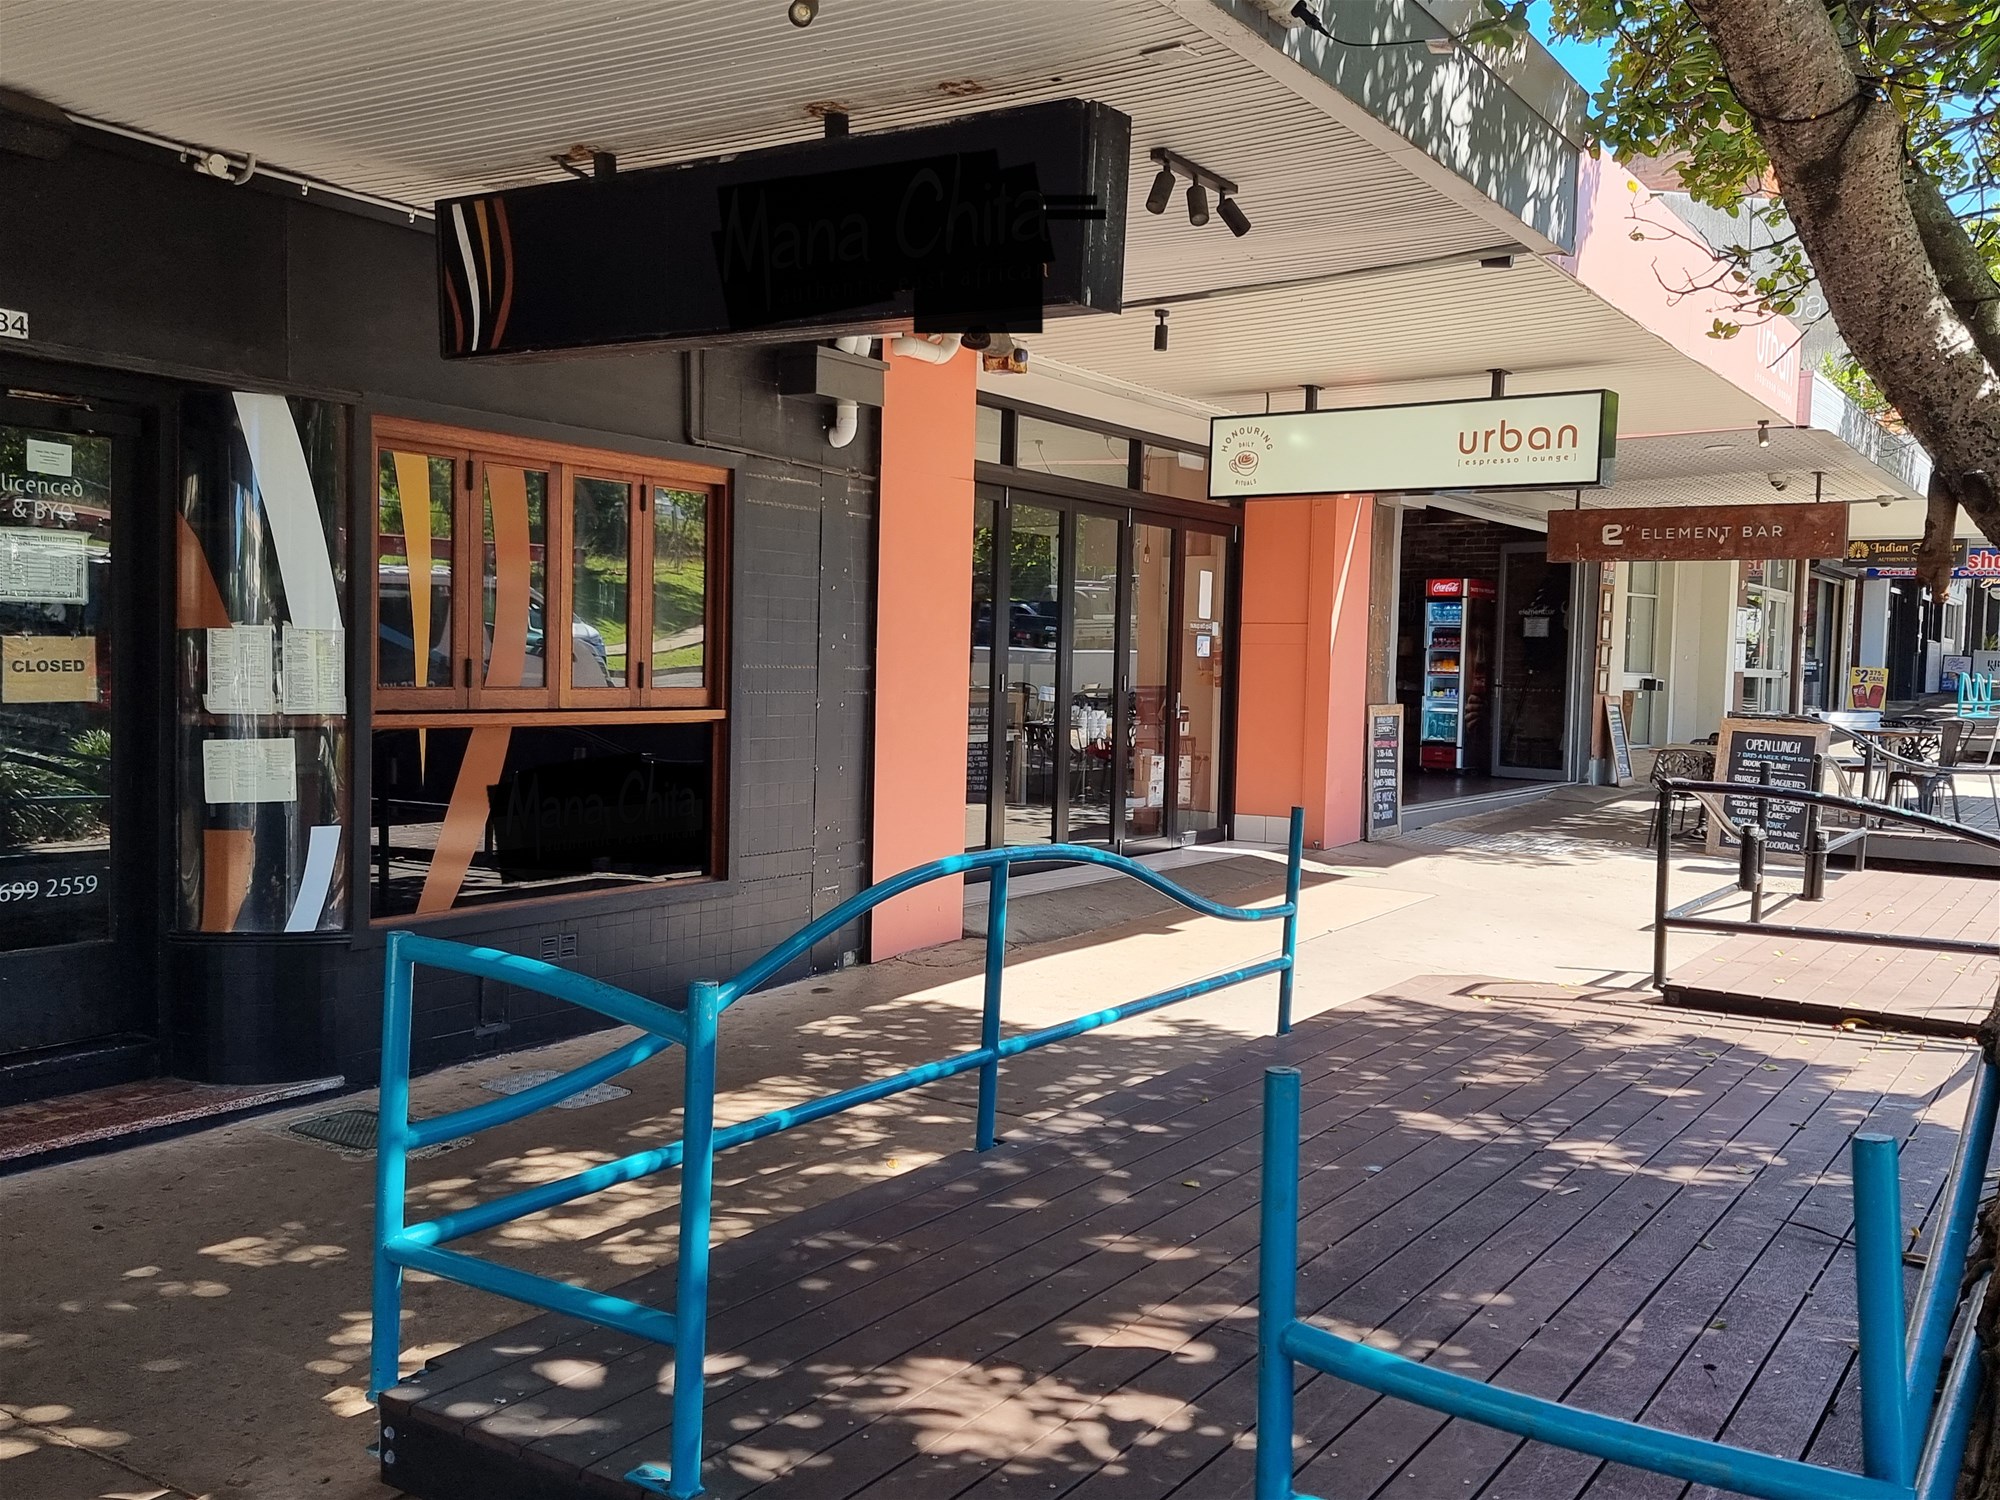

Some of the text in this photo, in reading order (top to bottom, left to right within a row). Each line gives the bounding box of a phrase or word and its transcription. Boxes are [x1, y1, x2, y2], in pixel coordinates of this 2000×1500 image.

[723, 152, 1049, 312] Mana Chita
[1221, 426, 1273, 452] HONOURING
[1459, 420, 1578, 454] urban
[1, 472, 83, 497] licenced
[1235, 478, 1256, 486] RITUALS
[12, 499, 27, 518] &
[1641, 526, 1732, 540] ELEMENT
[1742, 525, 1783, 538] BAR
[1870, 542, 1909, 553] Indian
[11, 659, 85, 673] CLOSED
[1855, 669, 1868, 683] $2
[1746, 738, 1801, 754] OPEN LUNCH
[0, 875, 98, 902] 699 2559
